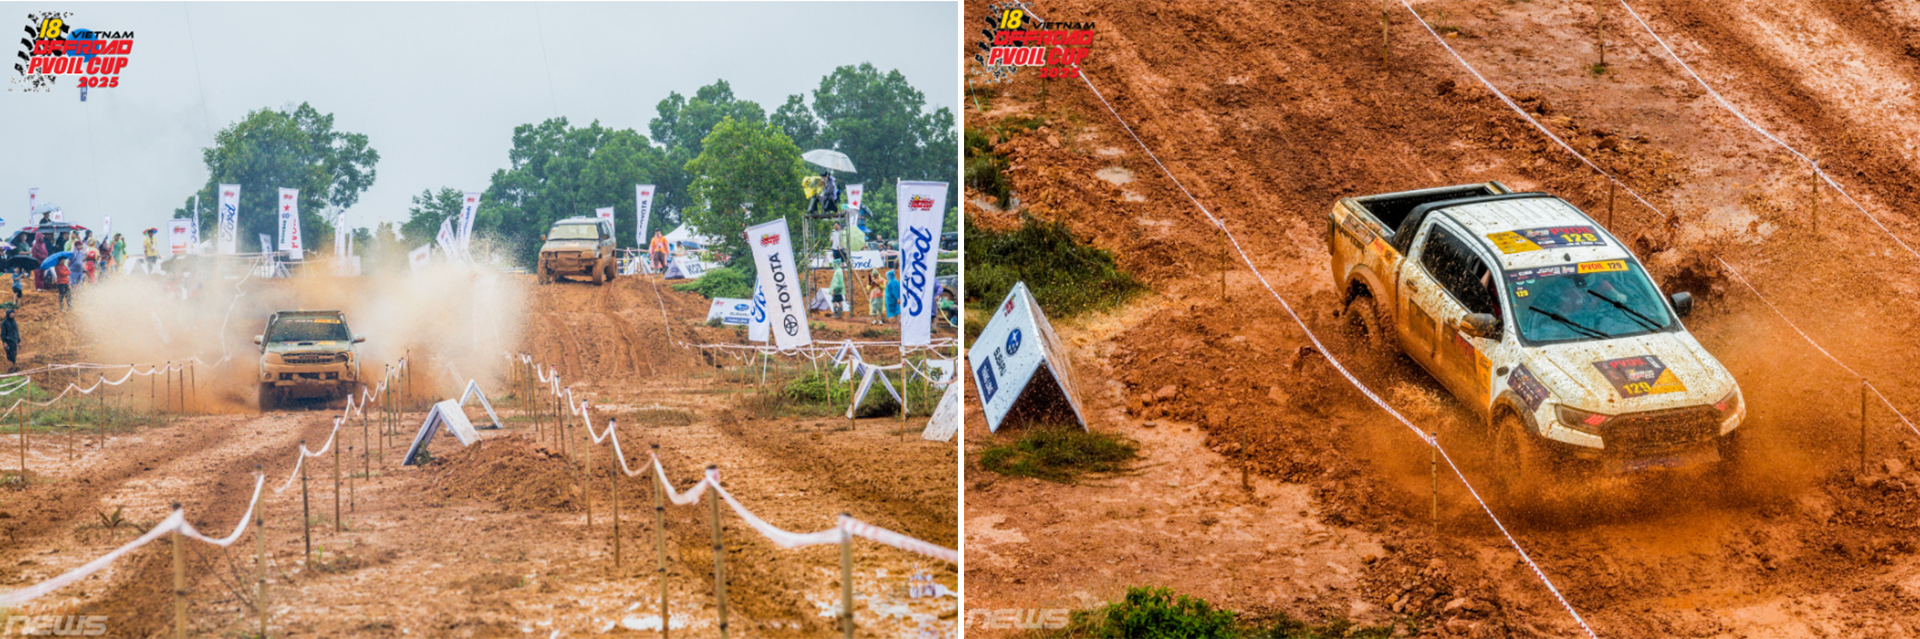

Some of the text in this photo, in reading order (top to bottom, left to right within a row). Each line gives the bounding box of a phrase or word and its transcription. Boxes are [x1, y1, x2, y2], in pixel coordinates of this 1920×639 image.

[221, 203, 236, 242] Ford
[1549, 226, 1595, 235] PVOIL
[1560, 233, 1598, 242] 129
[902, 225, 932, 317] Ford
[1581, 262, 1604, 271] PVOIL
[1607, 261, 1623, 270] 129
[768, 251, 792, 313] TOYOTA
[1515, 289, 1529, 298] 129
[1609, 358, 1648, 369] PVOIL
[1623, 381, 1652, 395] 129
